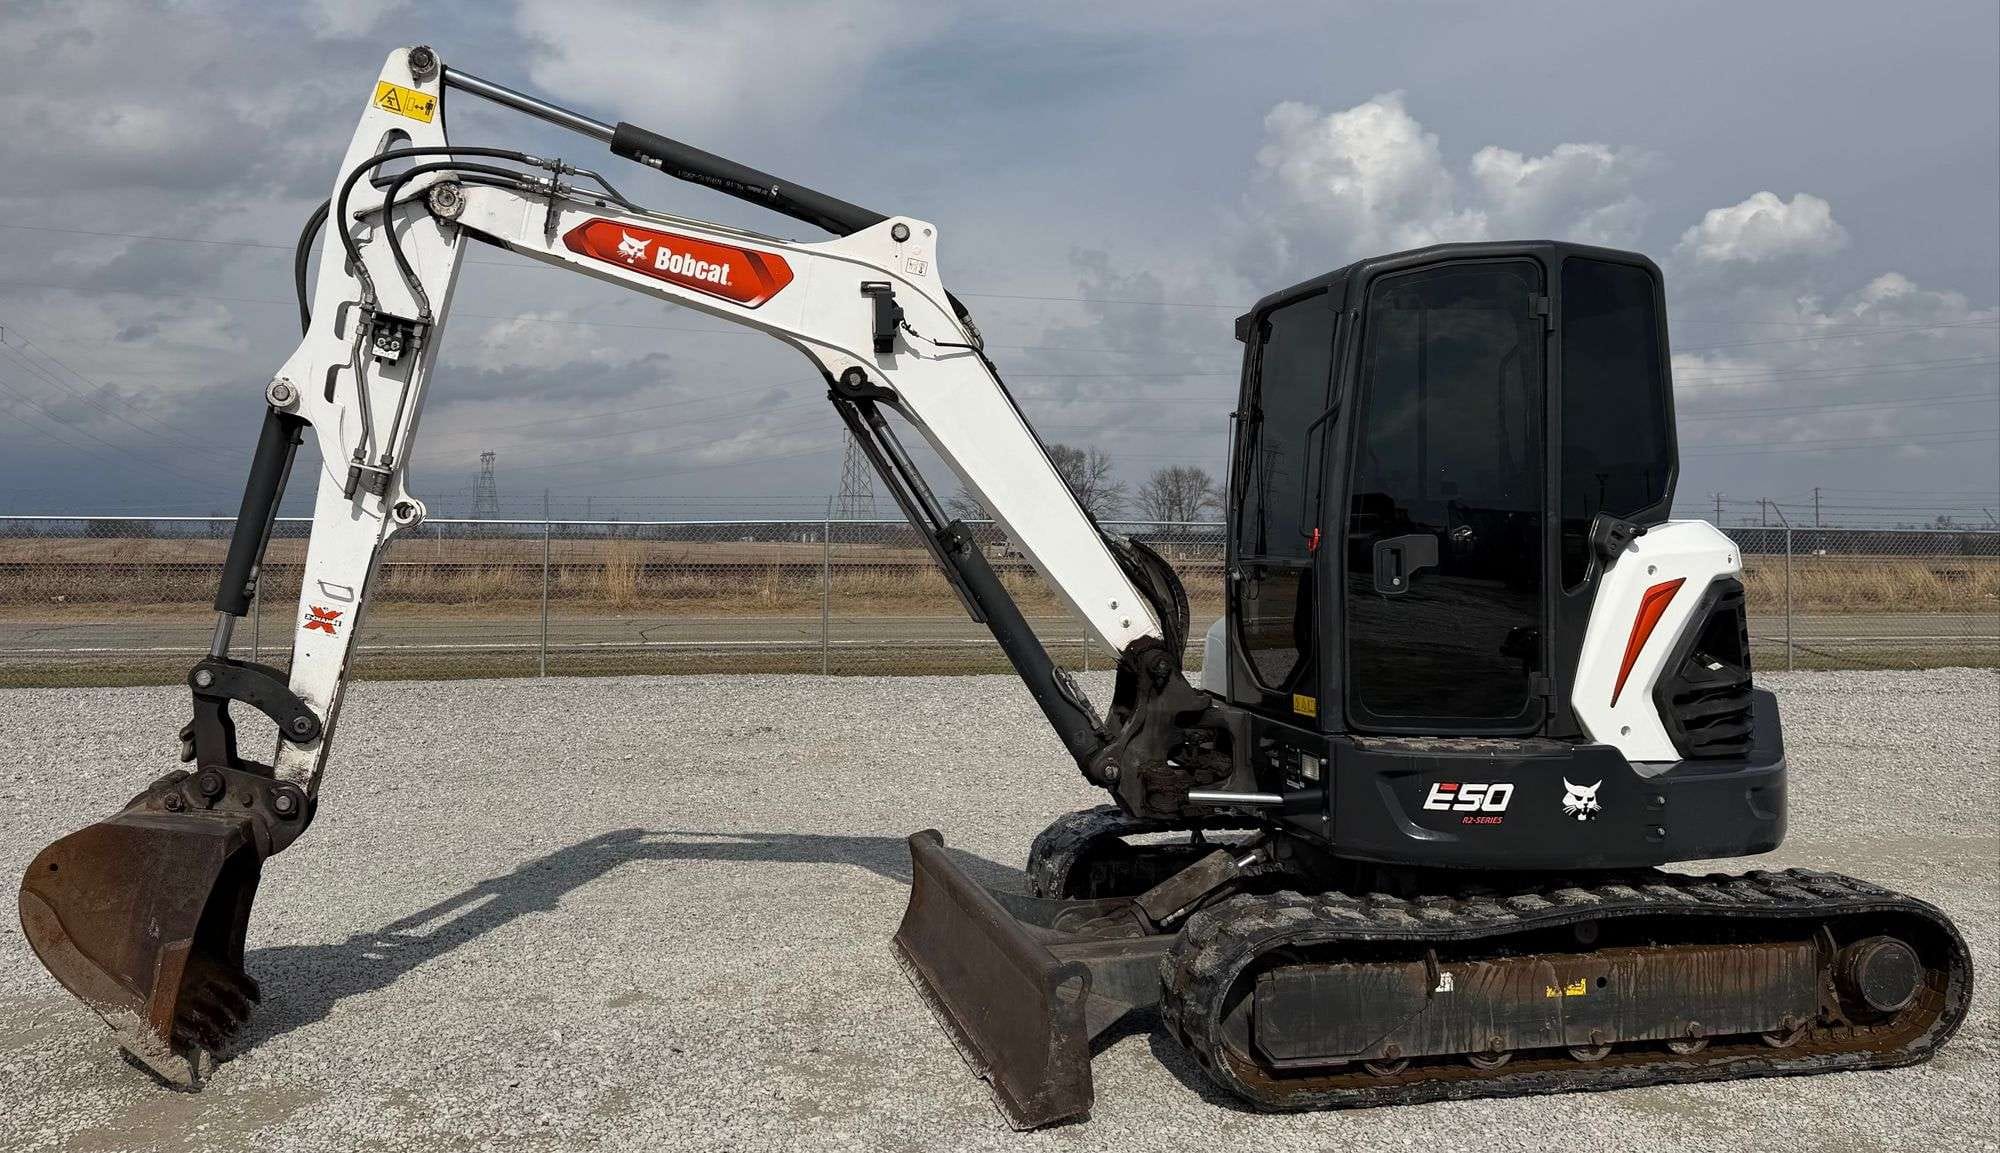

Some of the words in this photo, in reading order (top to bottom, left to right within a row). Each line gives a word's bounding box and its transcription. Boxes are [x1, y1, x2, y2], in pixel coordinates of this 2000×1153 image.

[655, 246, 730, 286] Bobcat
[1423, 783, 1515, 812] E50
[1462, 816, 1503, 824] R2-SERIES
